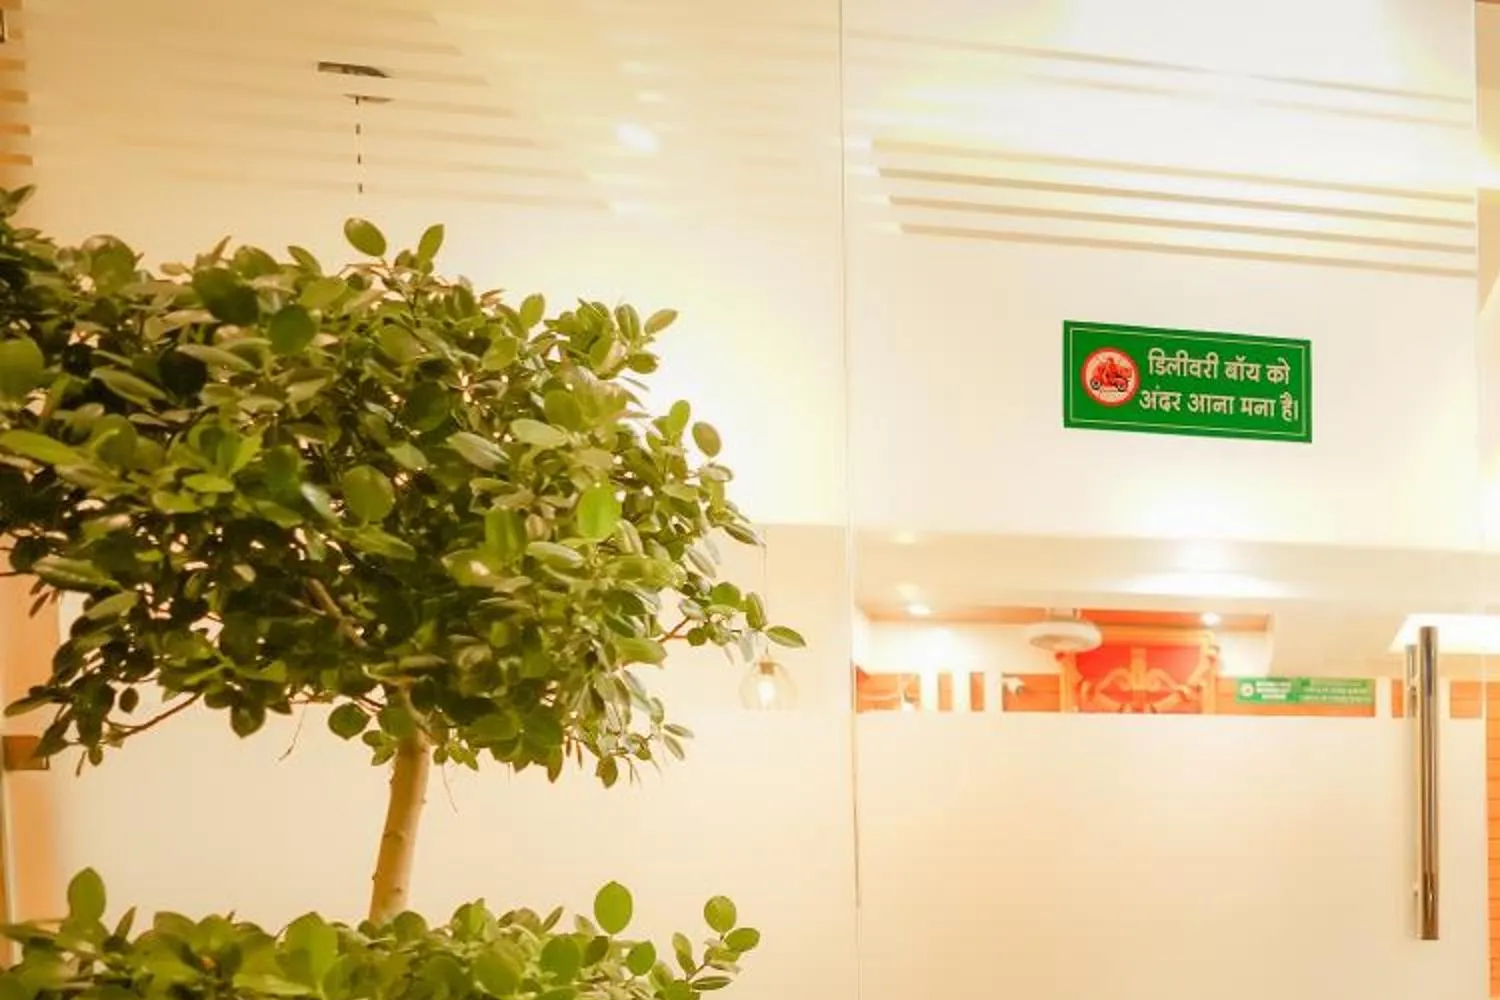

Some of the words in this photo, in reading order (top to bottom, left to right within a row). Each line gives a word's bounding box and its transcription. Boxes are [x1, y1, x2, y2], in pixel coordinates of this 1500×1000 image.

[1148, 347, 1219, 379] डिलीवरी
[1224, 355, 1261, 383] बॉय
[1266, 357, 1291, 385] को
[1139, 385, 1182, 411] अंदर
[1187, 391, 1234, 415] आना
[1240, 396, 1276, 417] मना
